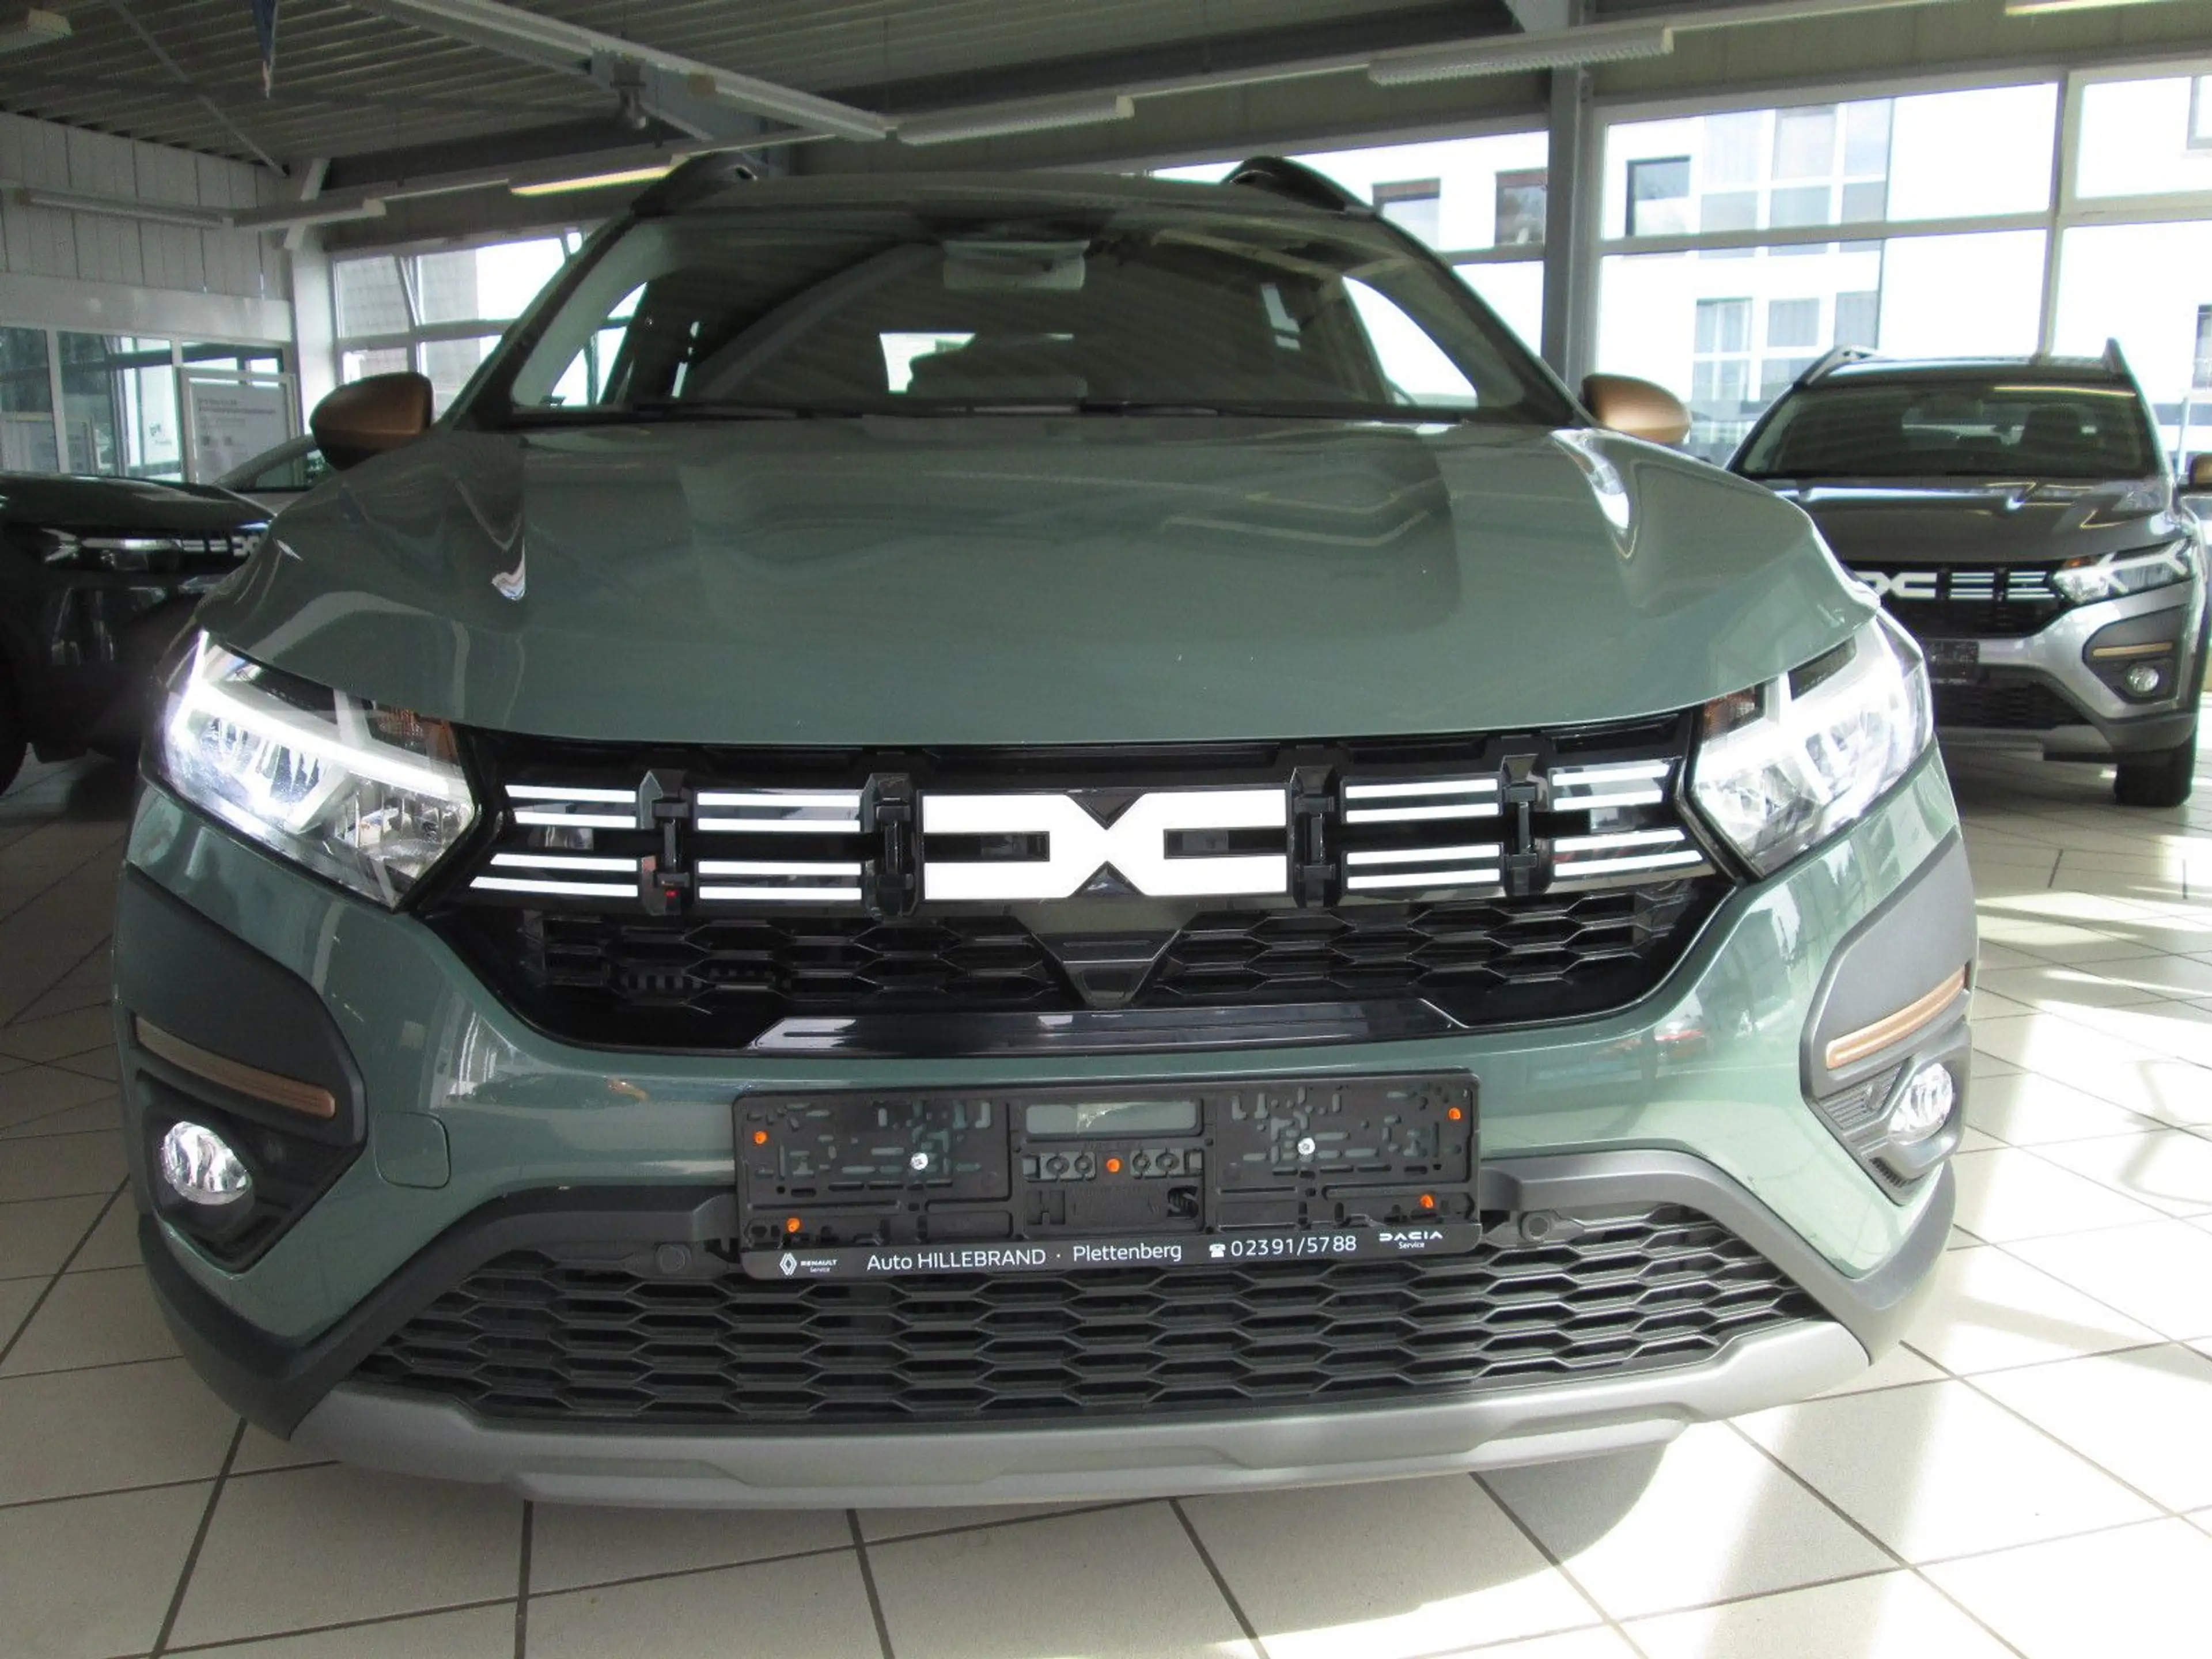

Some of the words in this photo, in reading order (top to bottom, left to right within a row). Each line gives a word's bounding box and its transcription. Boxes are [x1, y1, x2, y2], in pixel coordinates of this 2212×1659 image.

[1379, 1230, 1443, 1242] DACIA
[1399, 1241, 1425, 1249] Service
[866, 1254, 913, 1271] Auto
[917, 1248, 1047, 1268] HILLEBRAND
[1073, 1242, 1182, 1262] Plettenberg
[1230, 1235, 1357, 1257] 02391/5788
